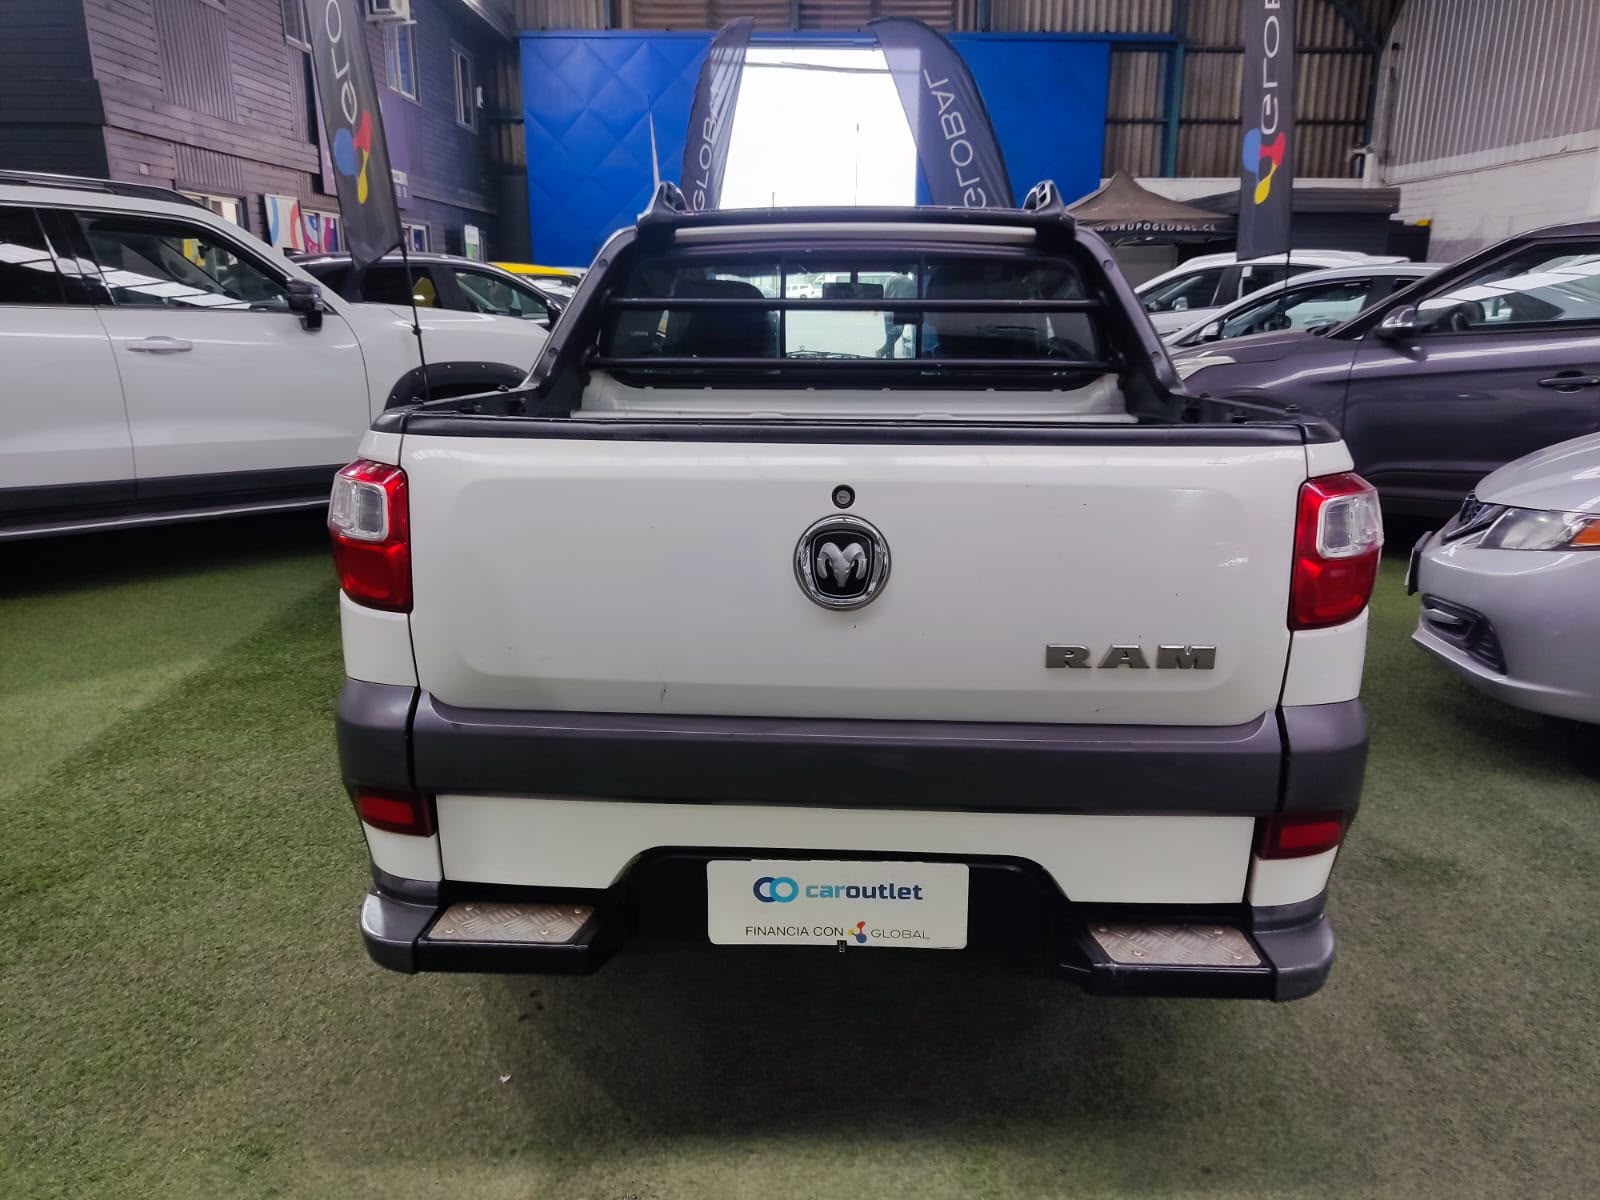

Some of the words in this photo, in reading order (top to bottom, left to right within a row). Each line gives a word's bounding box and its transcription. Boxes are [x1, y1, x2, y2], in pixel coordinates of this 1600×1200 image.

[1045, 644, 1217, 670] RAM
[805, 883, 924, 901] caroutlet
[745, 926, 810, 937] FINANCIA
[813, 927, 844, 937] CON
[870, 929, 931, 940] GLOBAL
